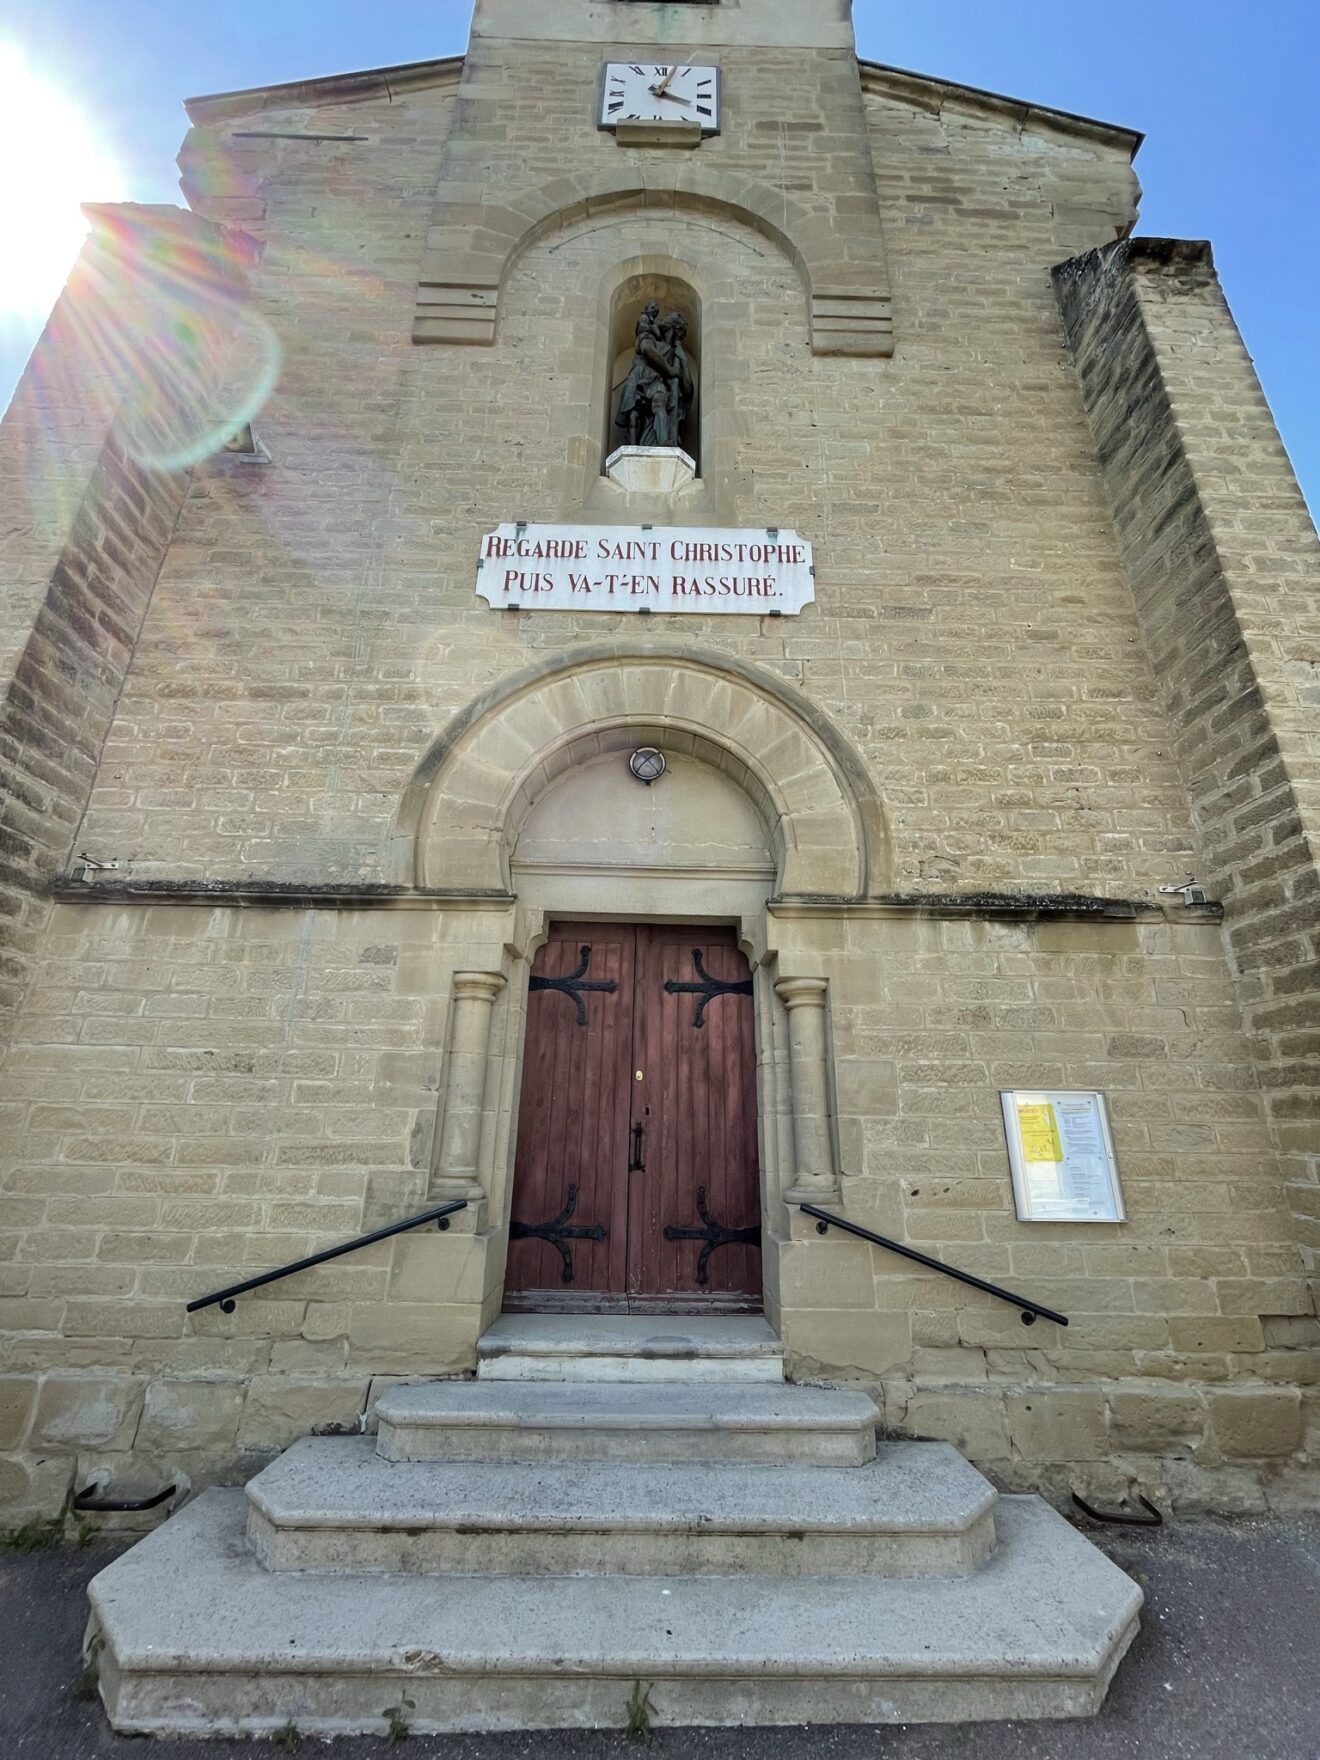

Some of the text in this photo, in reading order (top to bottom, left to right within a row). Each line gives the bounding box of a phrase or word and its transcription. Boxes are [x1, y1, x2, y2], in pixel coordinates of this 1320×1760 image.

[654, 67, 668, 77] XII
[486, 535, 806, 564] REGARDE SAINT CHRISTOPHE
[503, 570, 554, 592] PUIS
[672, 573, 783, 597] RASSURÉ.
